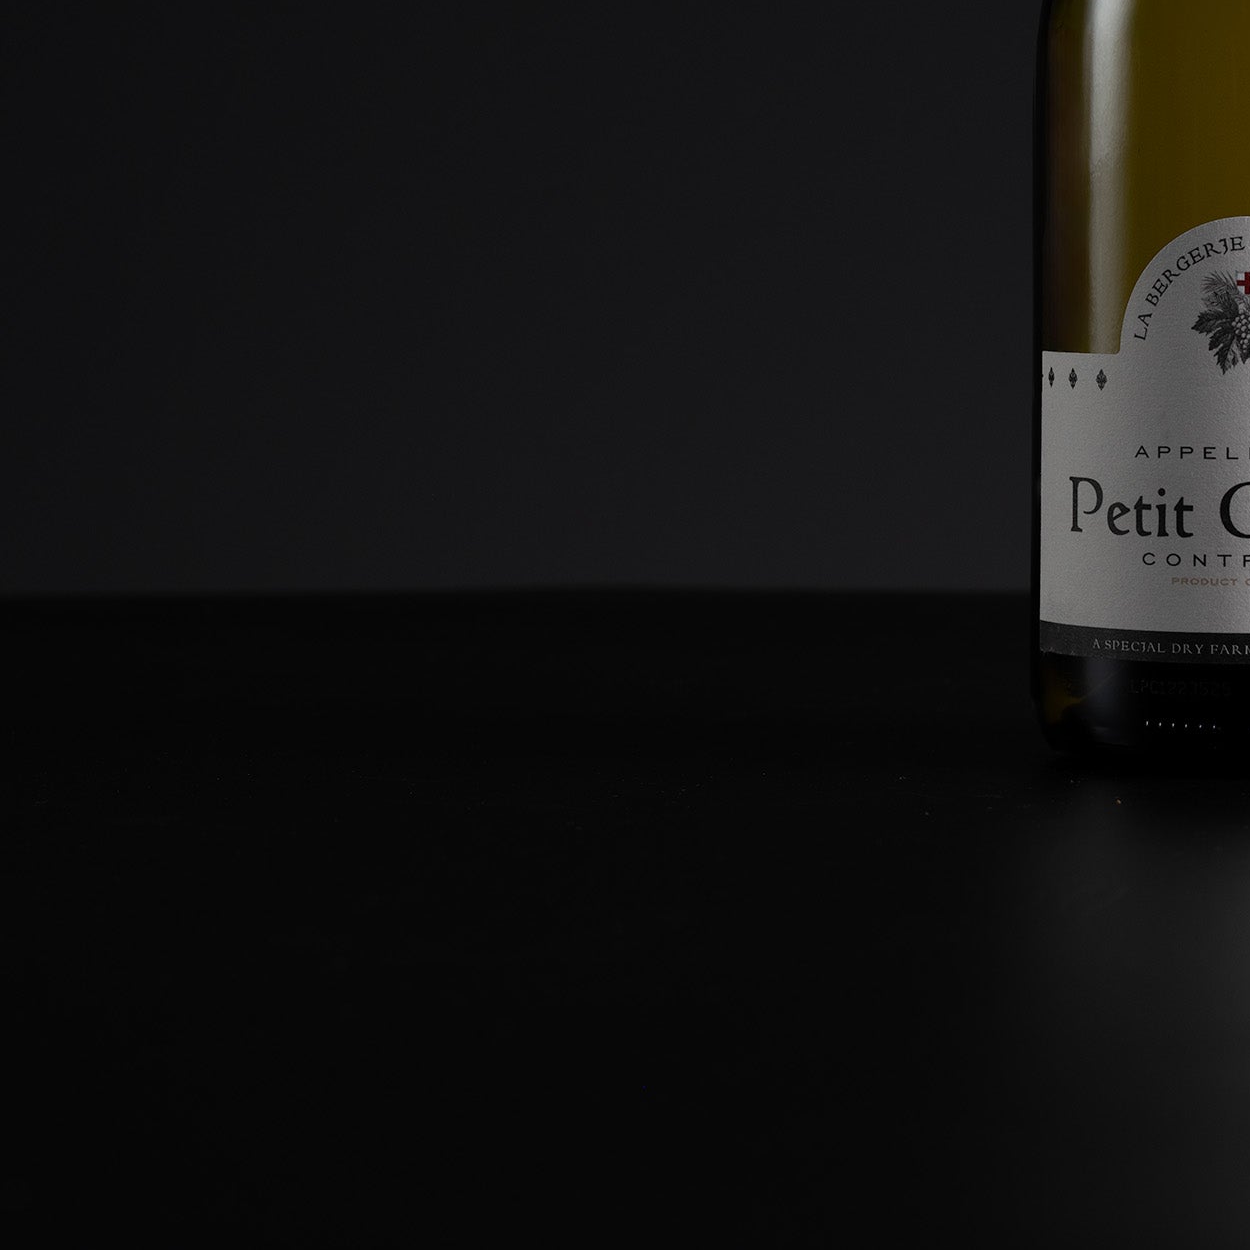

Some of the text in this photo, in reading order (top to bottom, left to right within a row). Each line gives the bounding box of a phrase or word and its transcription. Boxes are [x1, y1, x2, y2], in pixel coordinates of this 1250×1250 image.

[1133, 312, 1153, 341] LA
[1068, 476, 1195, 539] Petit
[1171, 576, 1238, 587] PRODUCT
[1092, 638, 1101, 650] A
[1172, 643, 1204, 655] DRY
